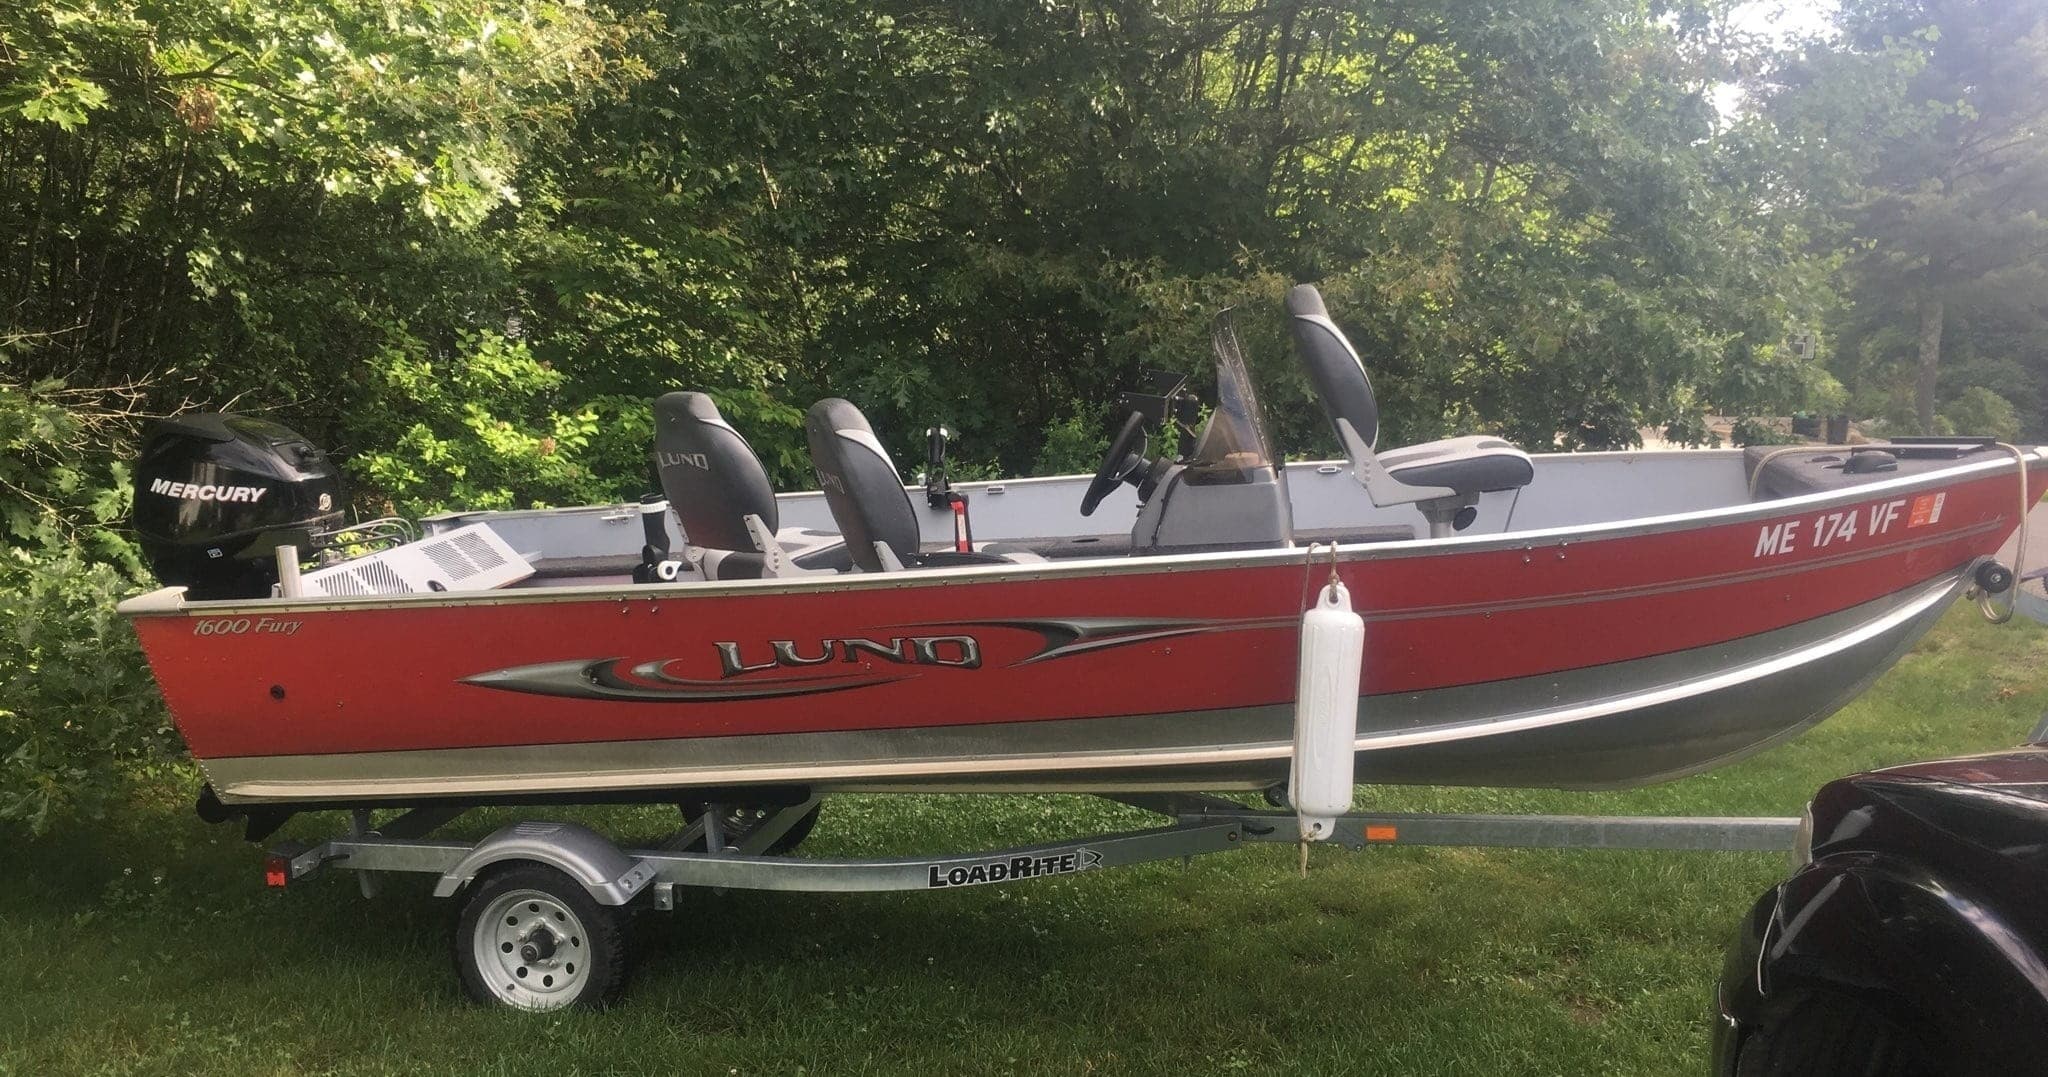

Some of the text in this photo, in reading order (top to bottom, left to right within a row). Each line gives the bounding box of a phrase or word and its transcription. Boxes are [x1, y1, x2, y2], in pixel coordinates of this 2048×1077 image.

[656, 451, 709, 471] LUND
[150, 478, 267, 503] MERCURY
[1754, 520, 1800, 558] ME
[1813, 509, 1858, 548] 174
[1869, 499, 1906, 537] VF
[193, 617, 303, 637] 1600 Fury
[713, 634, 983, 680] LUND
